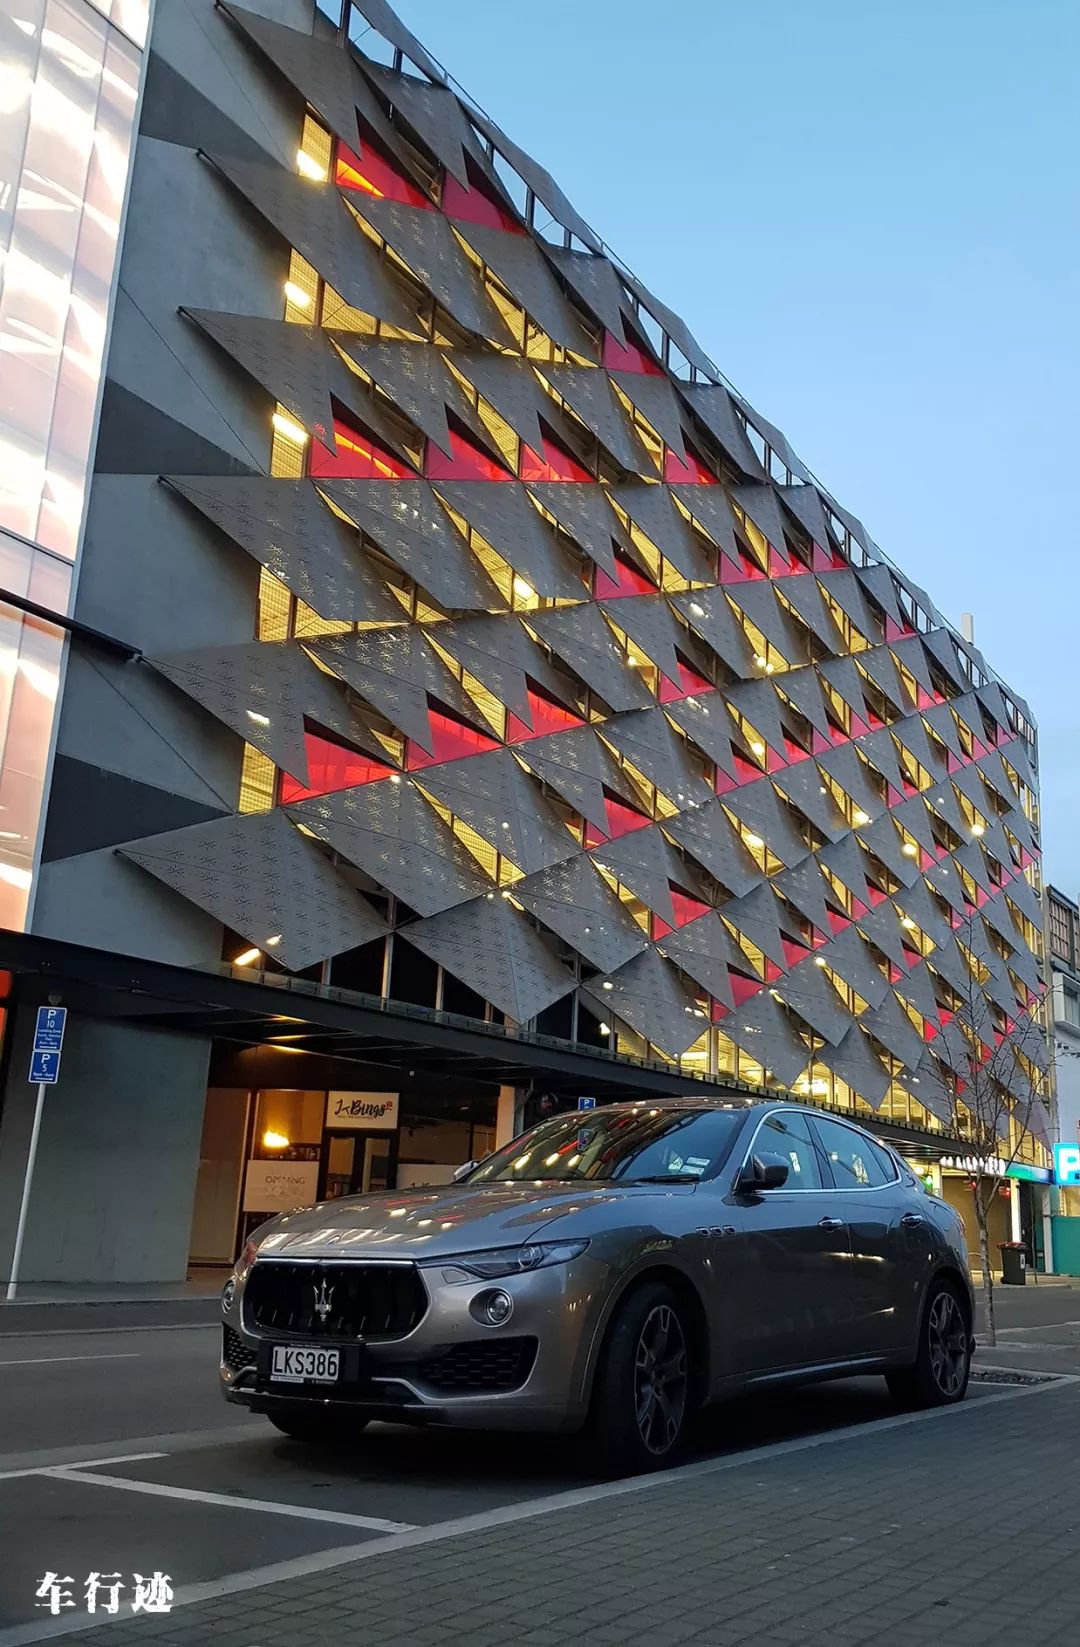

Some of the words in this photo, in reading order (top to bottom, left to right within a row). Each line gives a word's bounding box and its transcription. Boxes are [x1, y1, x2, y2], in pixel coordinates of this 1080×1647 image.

[47, 1010, 57, 1019] P
[46, 1020, 55, 1028] 10
[41, 1054, 51, 1063] P
[42, 1064, 47, 1072] 5
[1058, 1148, 1080, 1181] P
[273, 1350, 337, 1377] LKS386
